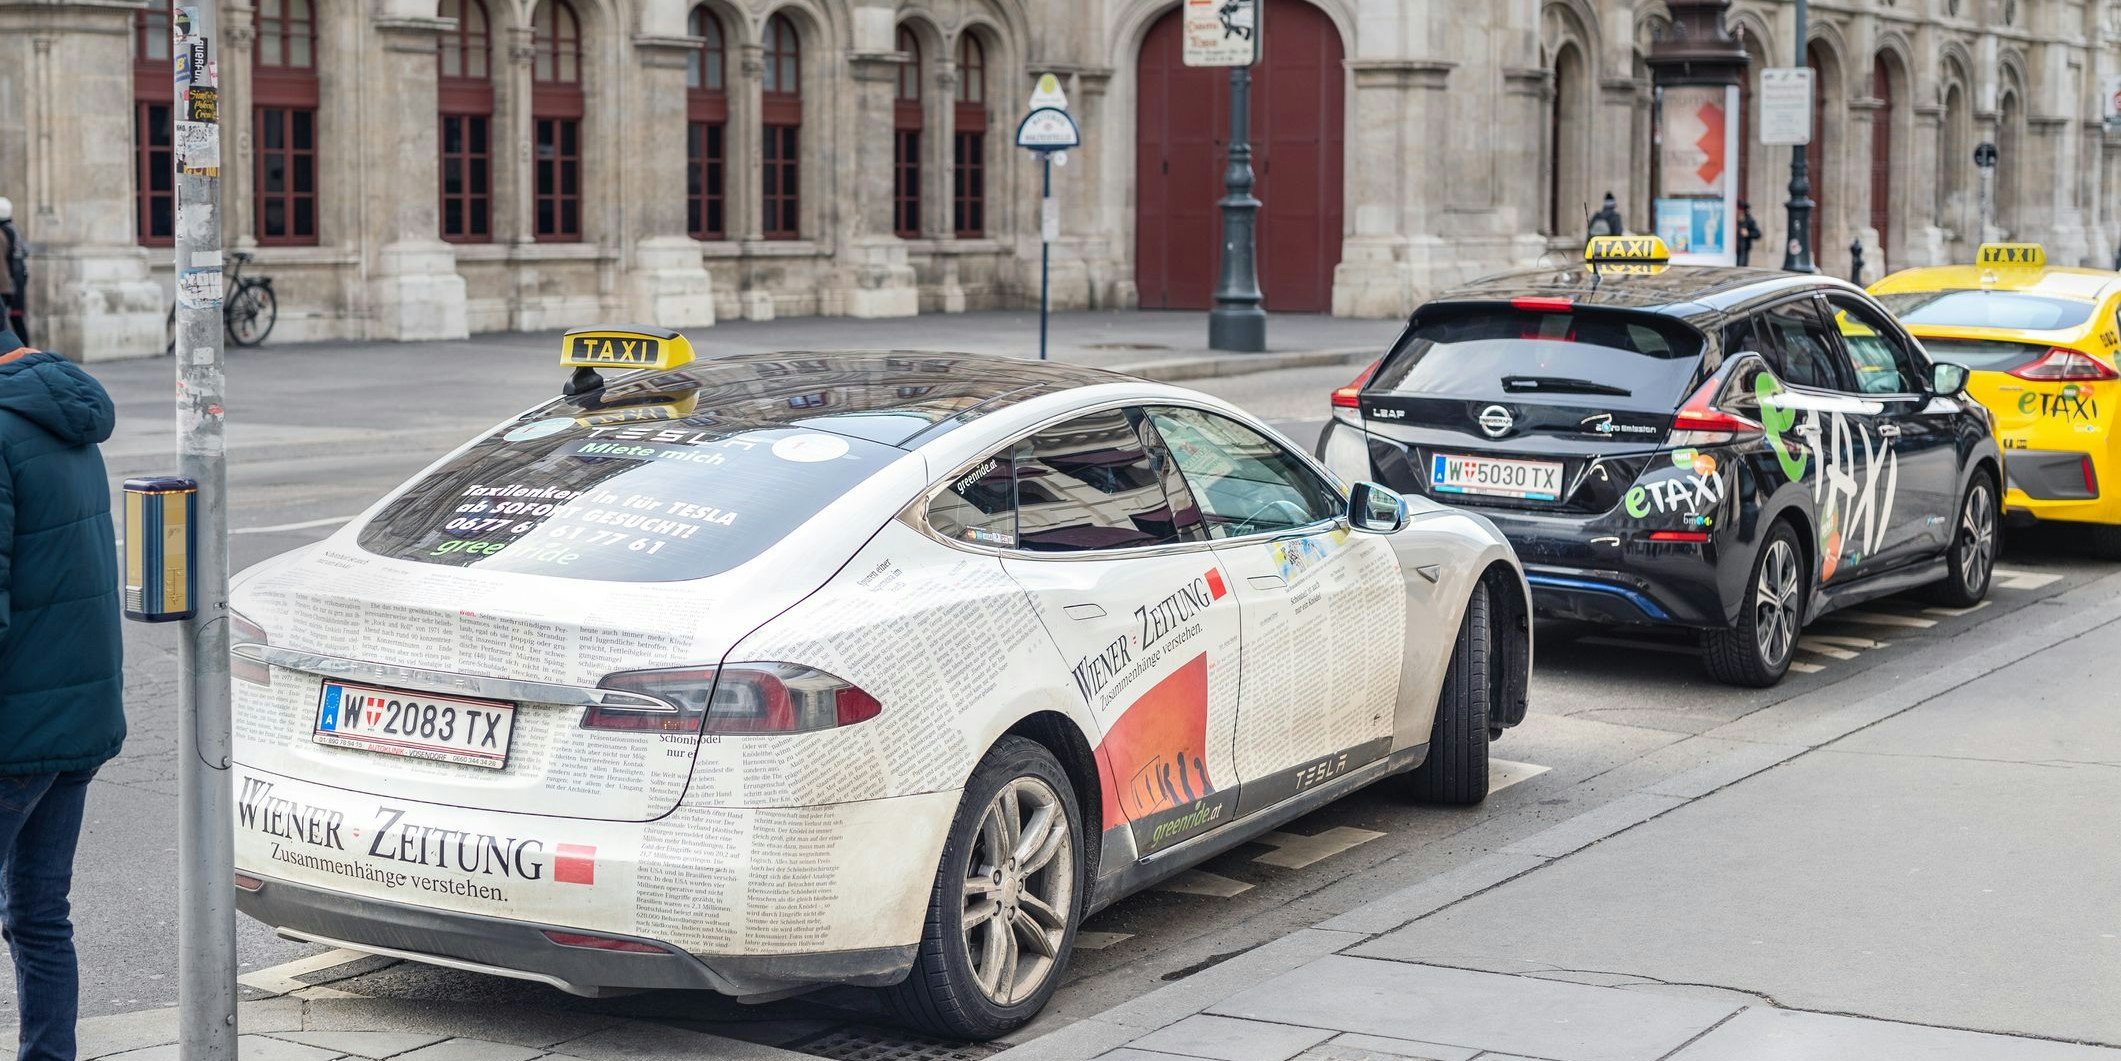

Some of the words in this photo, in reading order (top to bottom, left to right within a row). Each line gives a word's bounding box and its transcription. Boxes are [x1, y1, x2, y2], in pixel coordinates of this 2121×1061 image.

[1598, 240, 1649, 257] TAXI
[1986, 248, 2034, 262] TAXI
[584, 339, 648, 363] TAXI
[1373, 408, 1405, 418] LEAF
[1621, 425, 1656, 433] Emission
[578, 442, 656, 457] Miete
[658, 450, 726, 465] mich
[957, 459, 998, 495] greenride.at
[1449, 461, 1463, 481] W
[1478, 463, 1526, 486] 5030
[1532, 467, 1555, 488] TX
[455, 500, 489, 513] ab
[581, 508, 701, 539] GESUCHT!
[622, 494, 664, 510] für
[666, 501, 738, 526] TESLA
[445, 517, 514, 532] 0677
[550, 525, 587, 540] 61
[586, 530, 630, 546] 77
[628, 538, 667, 555] 61
[430, 540, 580, 565] greeride
[580, 626, 598, 634] heute
[622, 630, 643, 639] immer
[1072, 634, 1132, 704] WIENER
[1134, 577, 1210, 651] ZEITUNG
[481, 645, 511, 656] Performer
[1100, 650, 1161, 712] Zusammenhänge
[1162, 622, 1204, 655] verstehen.
[325, 714, 333, 725] A
[344, 694, 364, 728] W
[384, 700, 456, 741] 2083
[466, 710, 501, 748] TX
[588, 742, 627, 751] gemeinsamen
[666, 749, 685, 758] nur
[1295, 753, 1347, 789] TESLA
[568, 786, 600, 795] Architektur
[237, 775, 345, 851] WIENER
[368, 805, 545, 882] ZEITUNG
[1151, 801, 1223, 848] greenride.at
[270, 841, 408, 887] Zusammenhänge
[411, 874, 508, 903] verstehen.
